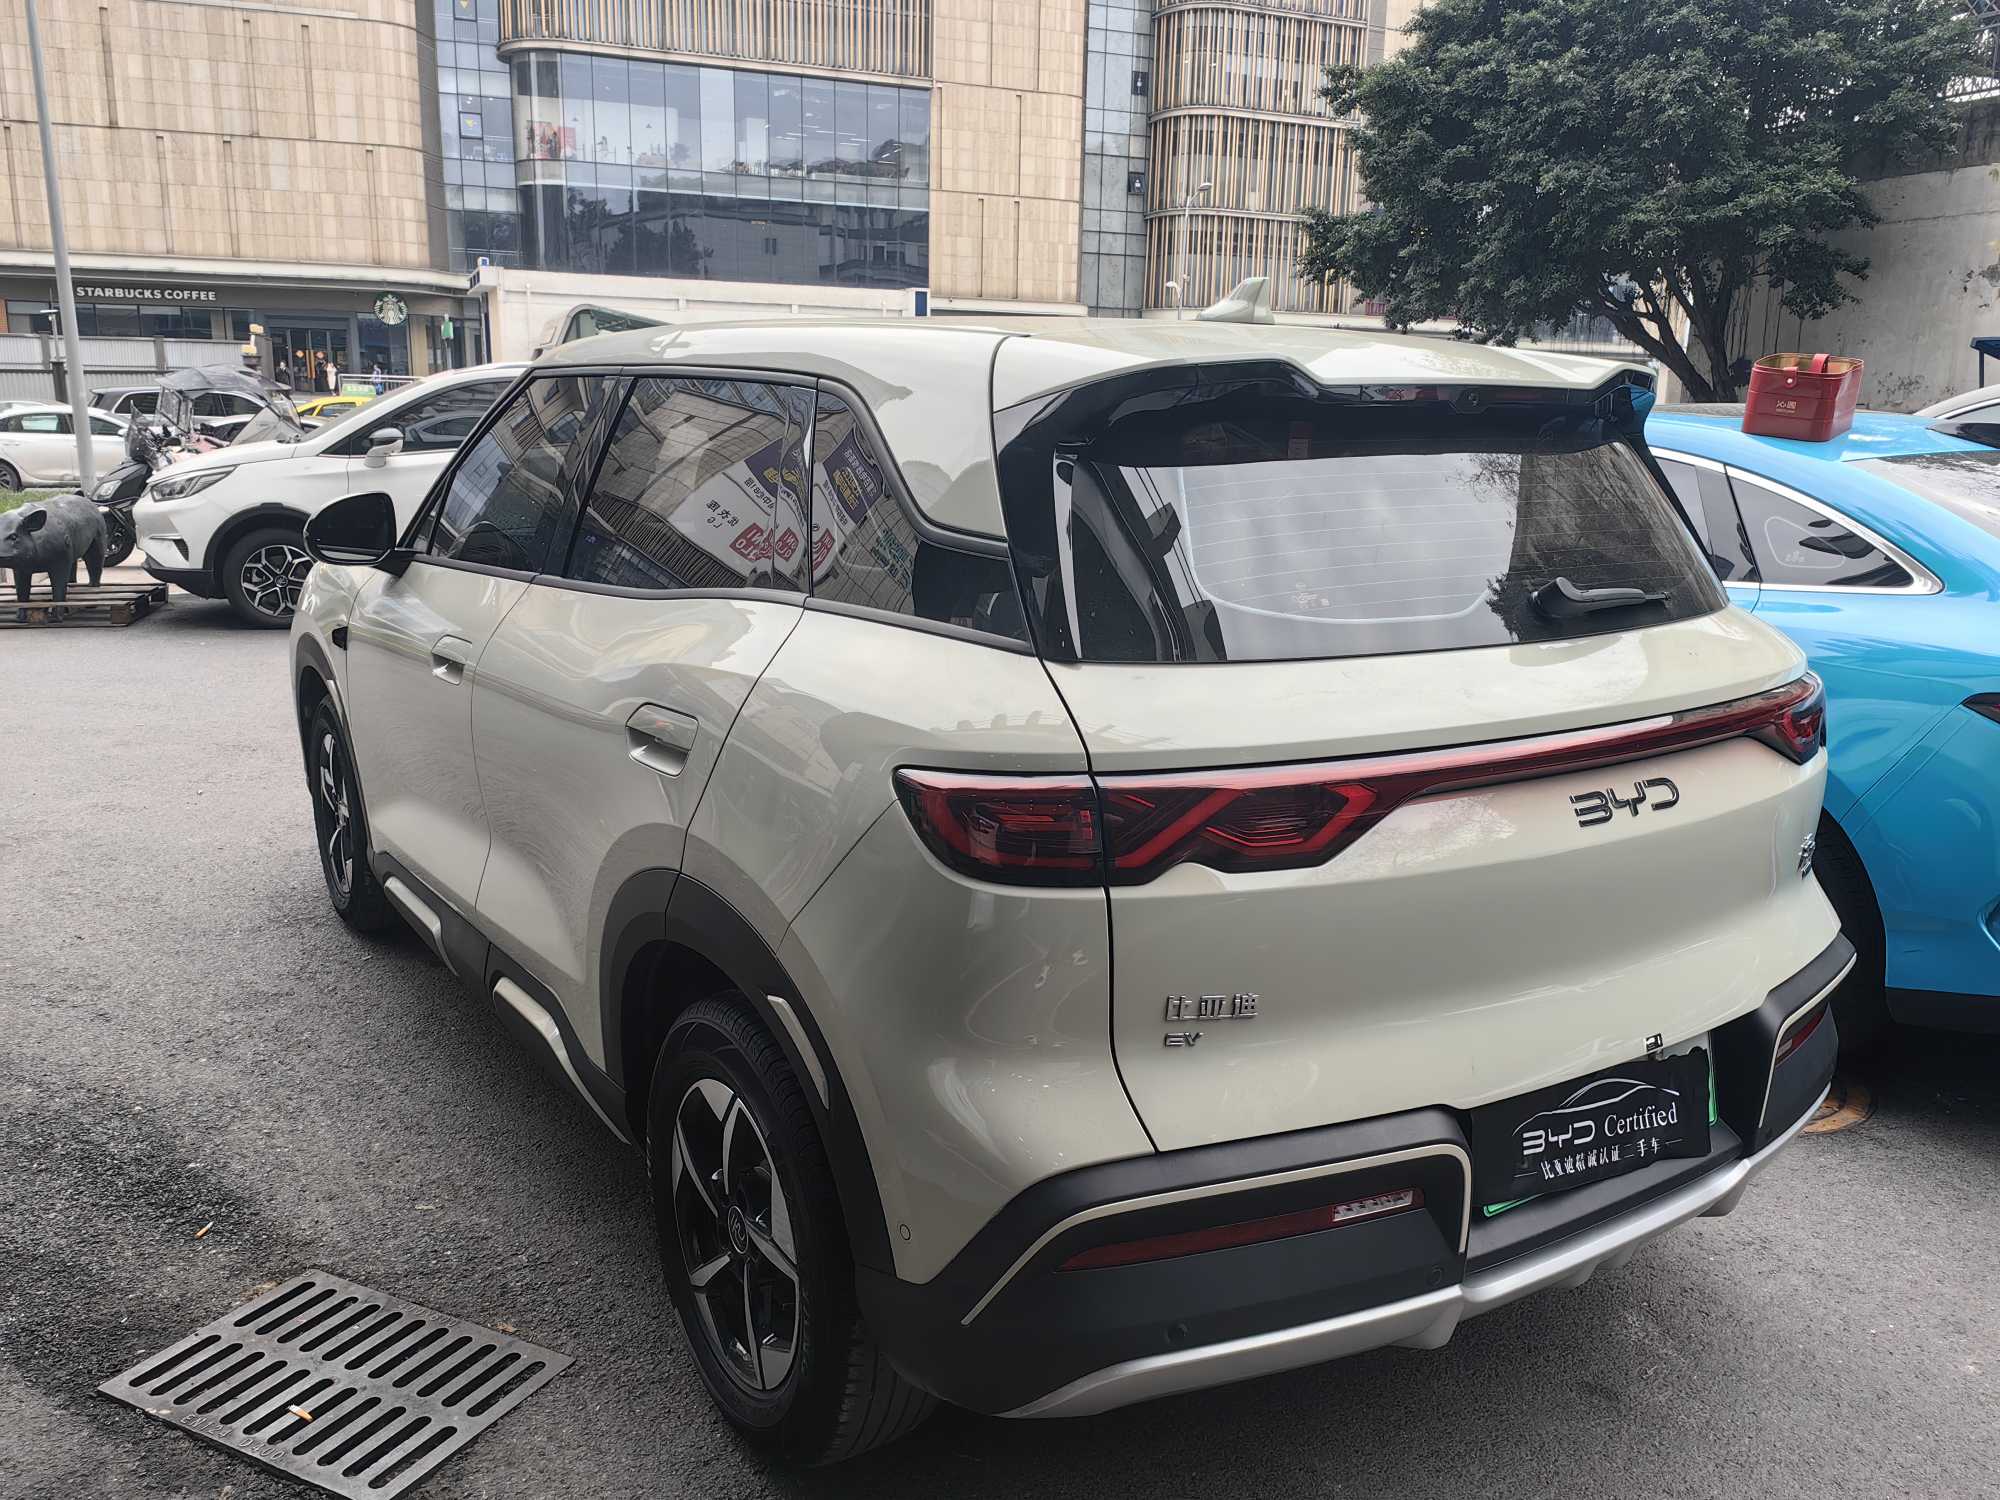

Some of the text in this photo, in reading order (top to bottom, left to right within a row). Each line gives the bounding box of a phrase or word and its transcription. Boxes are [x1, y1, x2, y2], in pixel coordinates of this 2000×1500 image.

[76, 286, 216, 301] STARBUCKS COFFEE
[1568, 777, 1680, 828] BYD
[1165, 992, 1261, 1021] 比亚迪
[1165, 1032, 1203, 1048] EV
[1522, 1101, 1679, 1156] BYD Certified
[238, 1438, 287, 1461] D400
